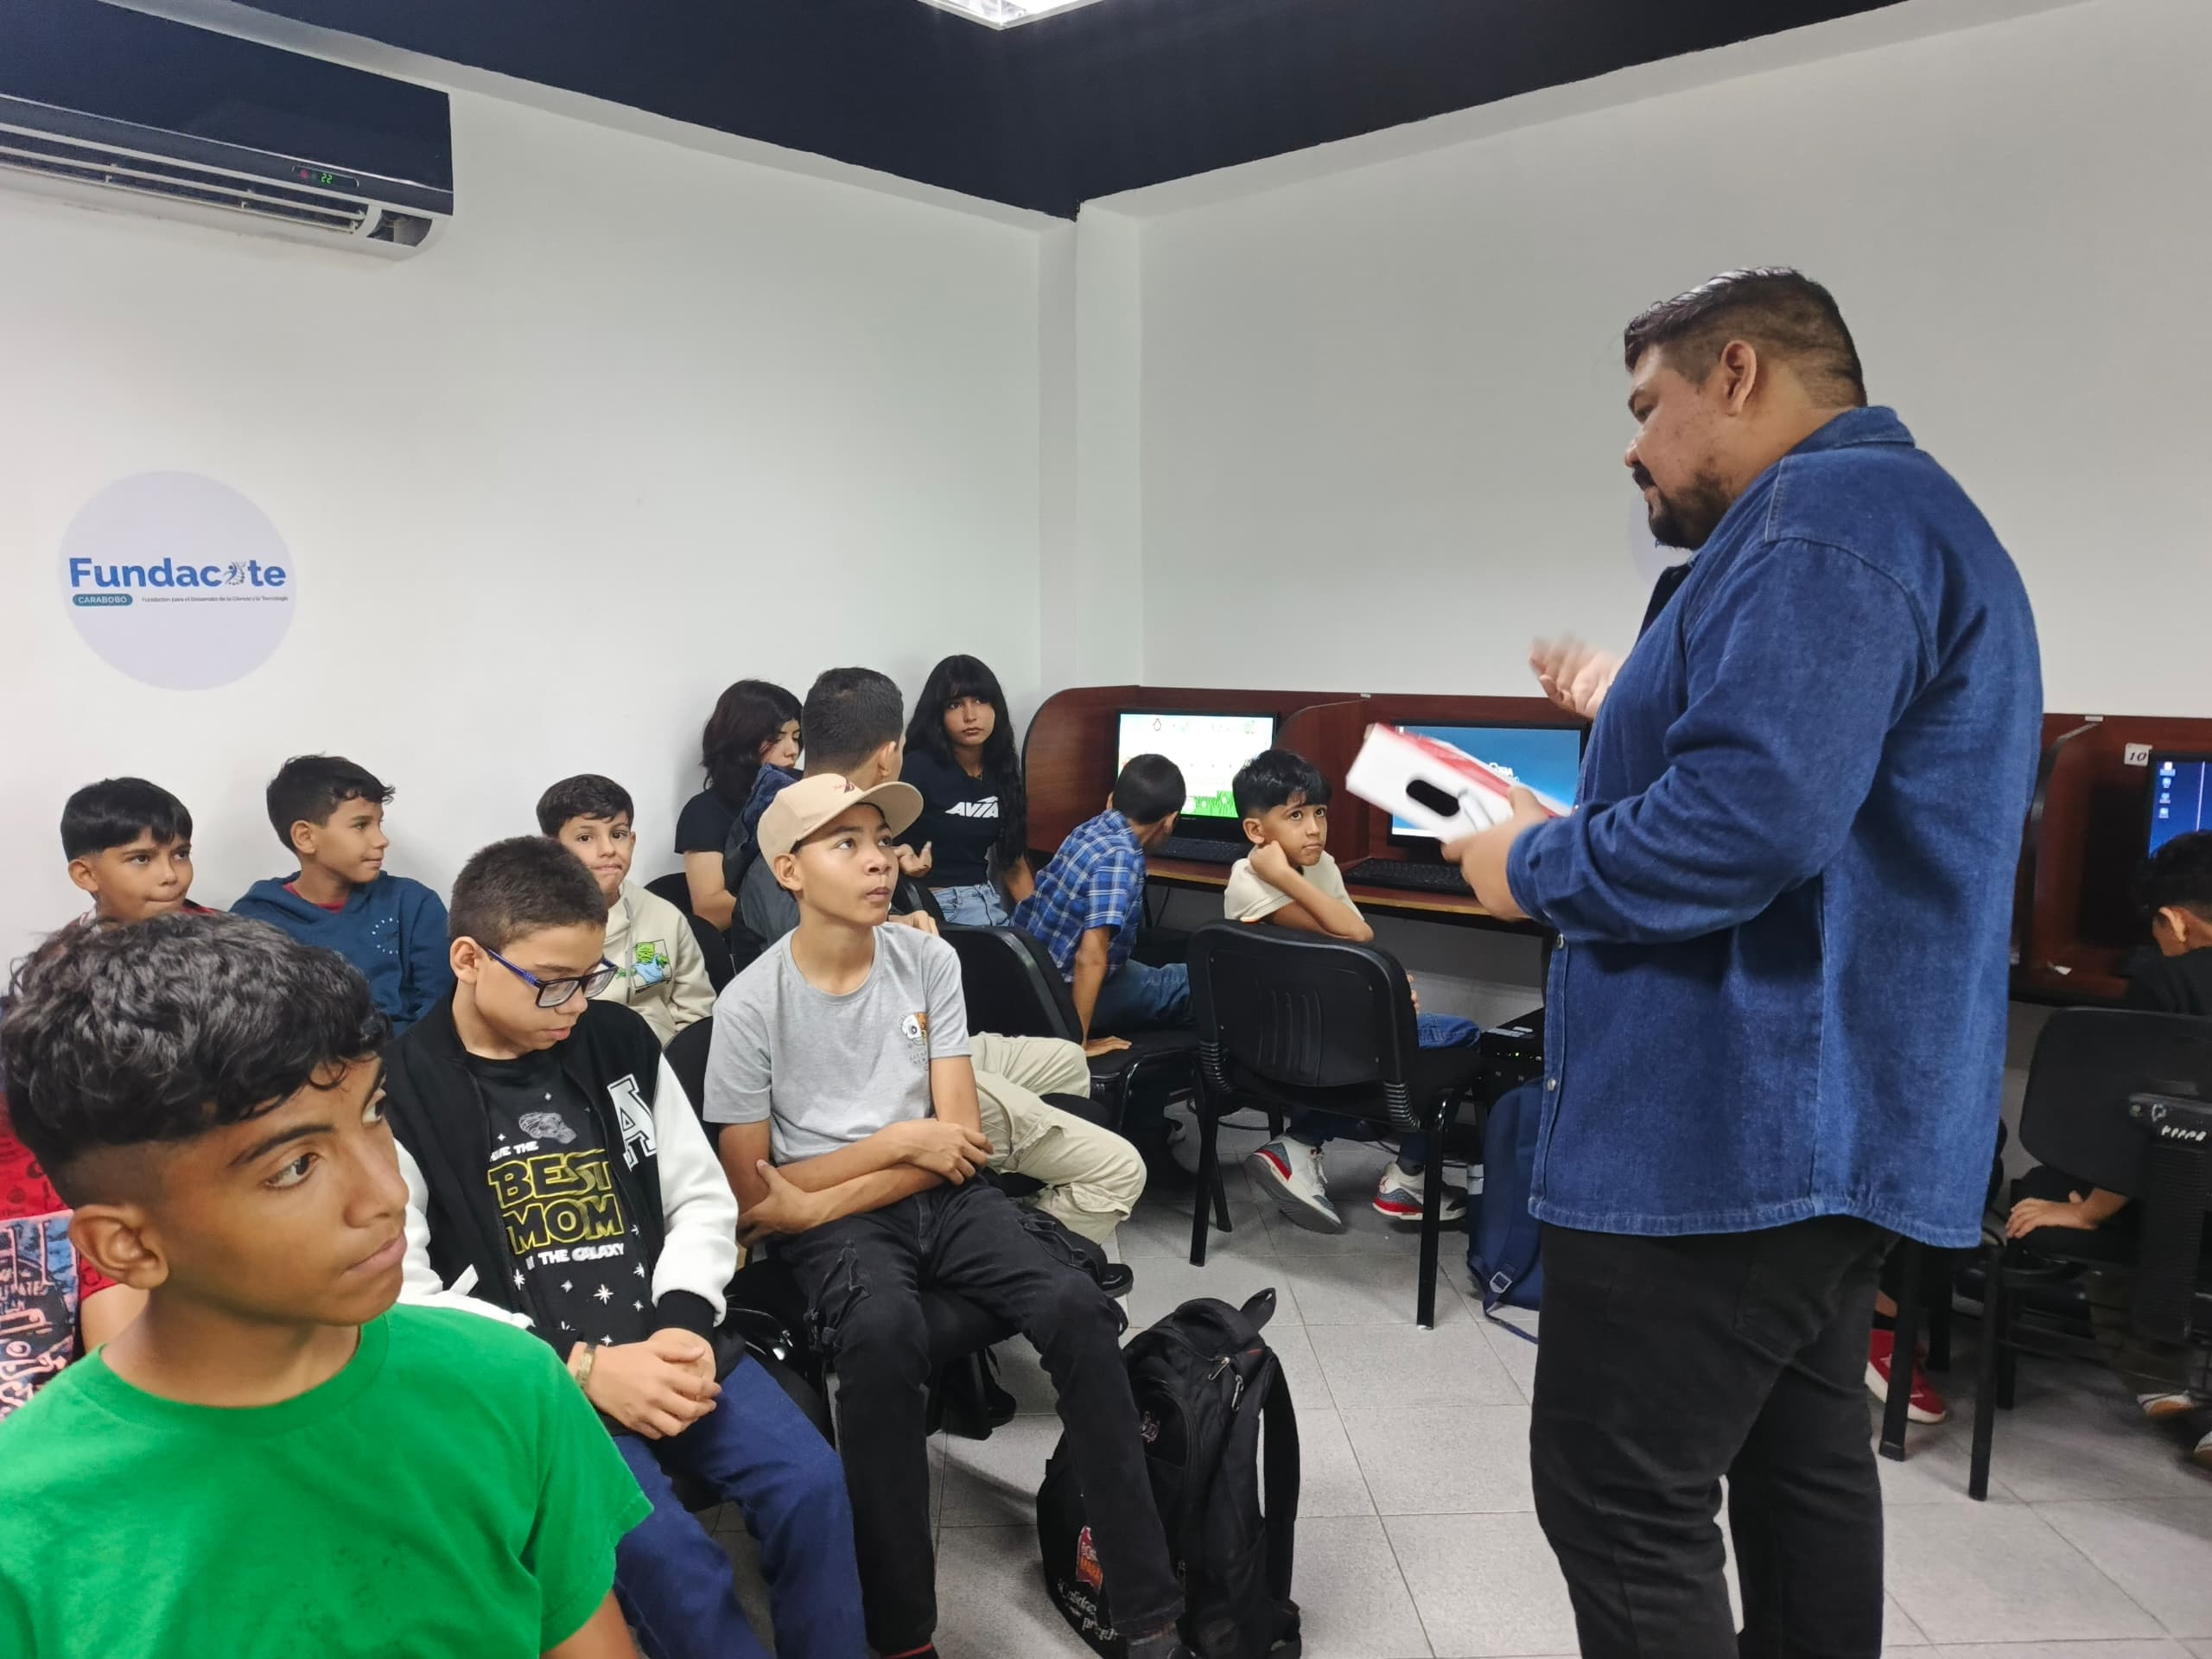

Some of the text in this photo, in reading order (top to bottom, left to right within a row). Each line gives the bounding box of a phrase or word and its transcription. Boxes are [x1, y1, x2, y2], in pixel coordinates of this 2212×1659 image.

[321, 172, 333, 184] 22
[78, 595, 128, 605] CARABOBO
[2128, 752, 2147, 762] 10
[944, 796, 999, 818] AVIA
[606, 1073, 658, 1172] A
[513, 1141, 539, 1154] THE
[488, 1147, 612, 1210] BEST
[502, 1194, 625, 1255] MOM
[537, 1249, 570, 1265] THE
